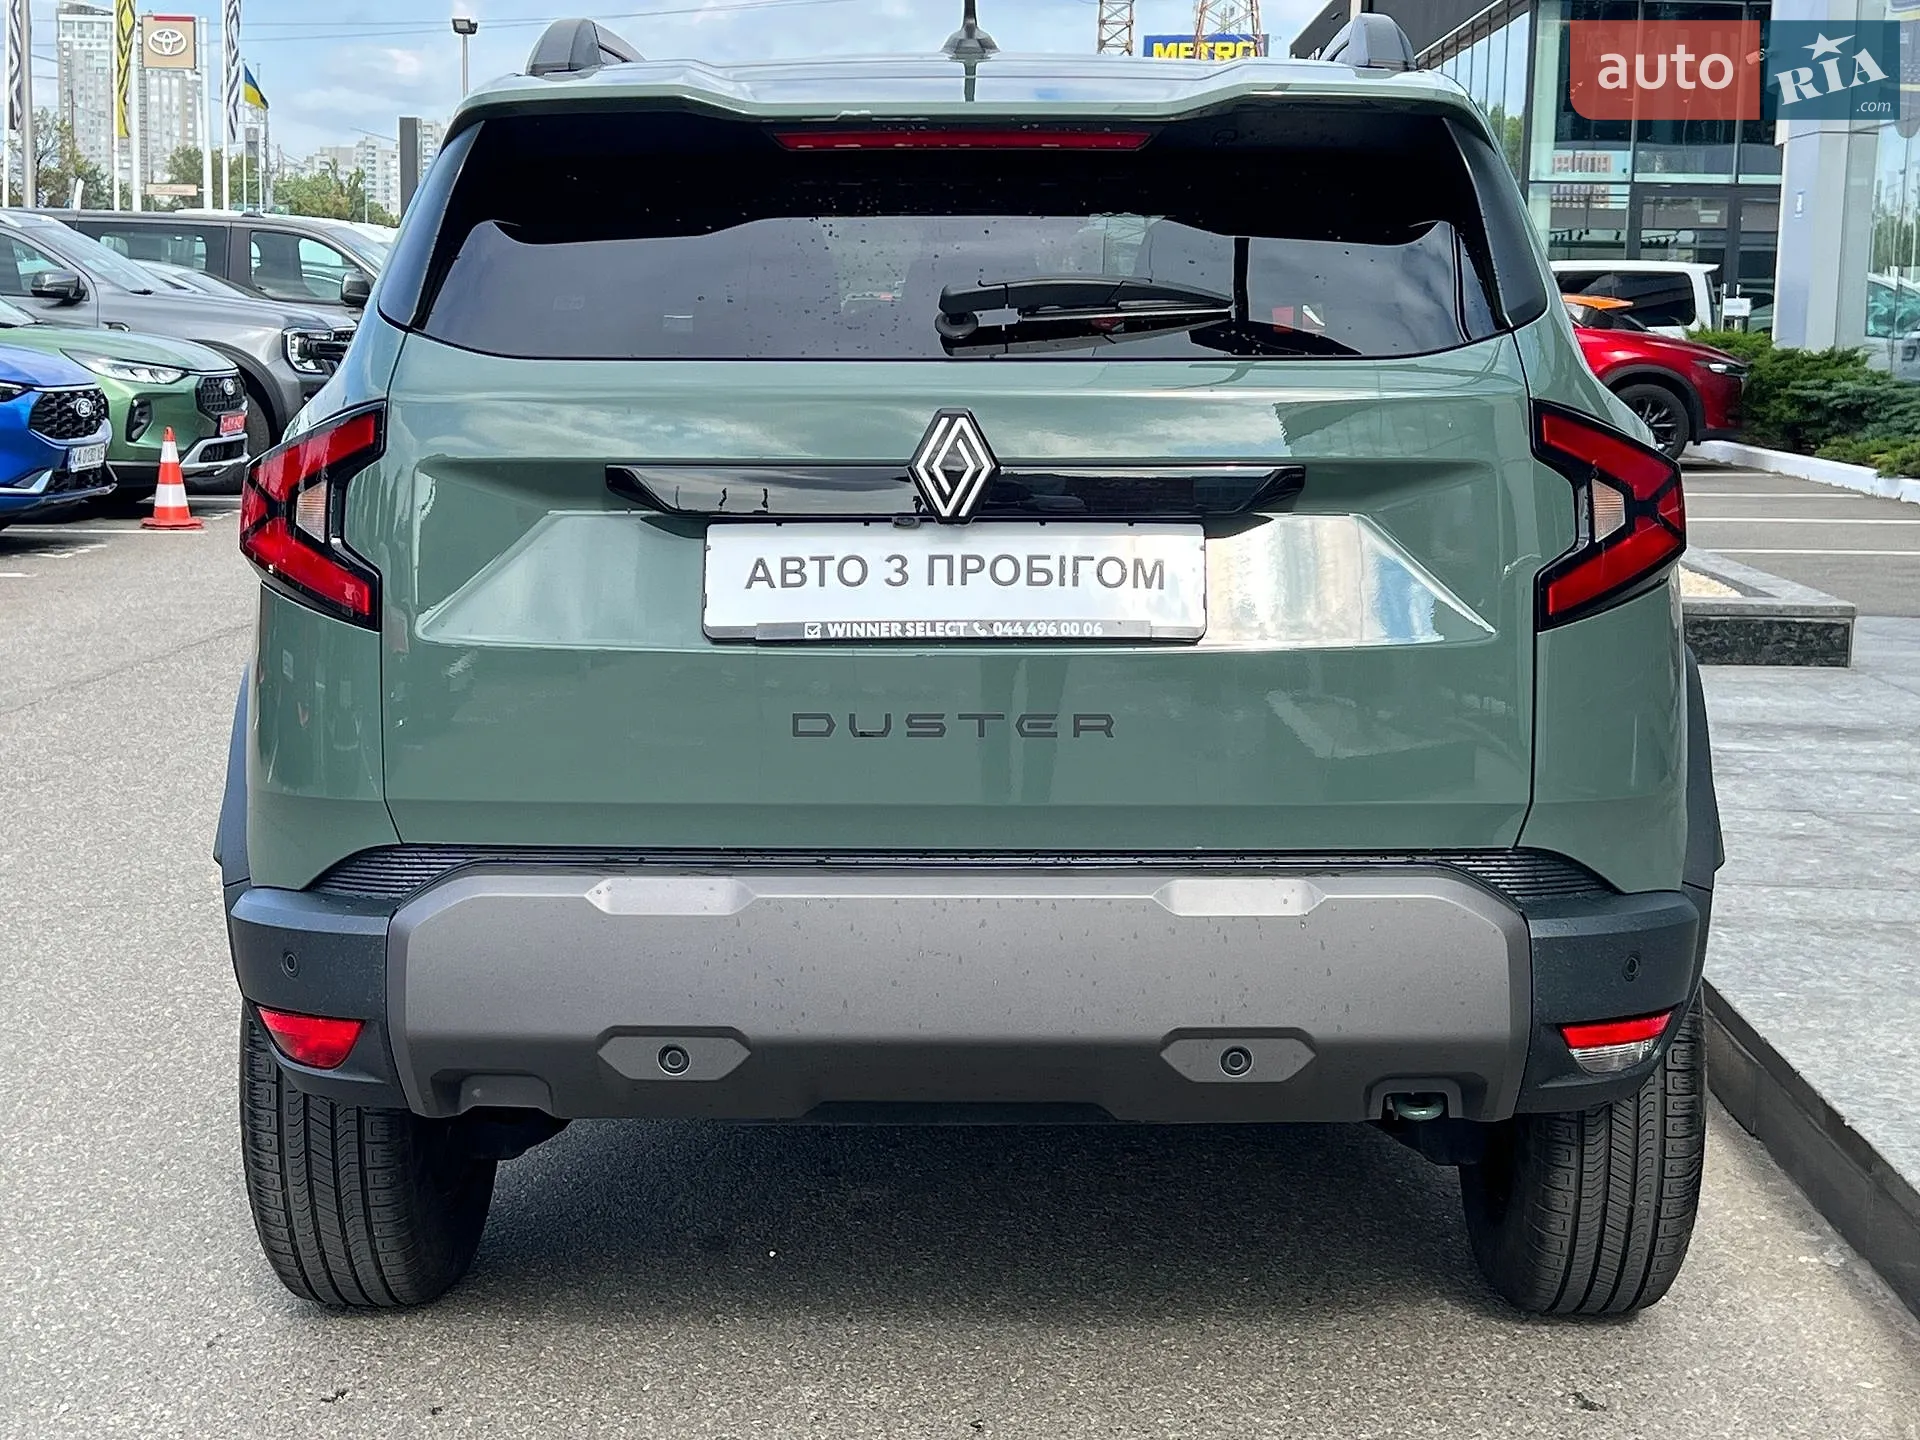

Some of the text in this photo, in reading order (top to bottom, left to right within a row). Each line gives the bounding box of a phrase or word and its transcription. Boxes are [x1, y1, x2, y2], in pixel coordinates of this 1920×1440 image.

[1153, 42, 1257, 60] METRO
[744, 554, 869, 590] АВТО
[927, 554, 1165, 590] ПРОБІГОМ
[827, 621, 1103, 637] WINNER SELECT 044 496 00 06
[791, 712, 1115, 739] DUSTER
